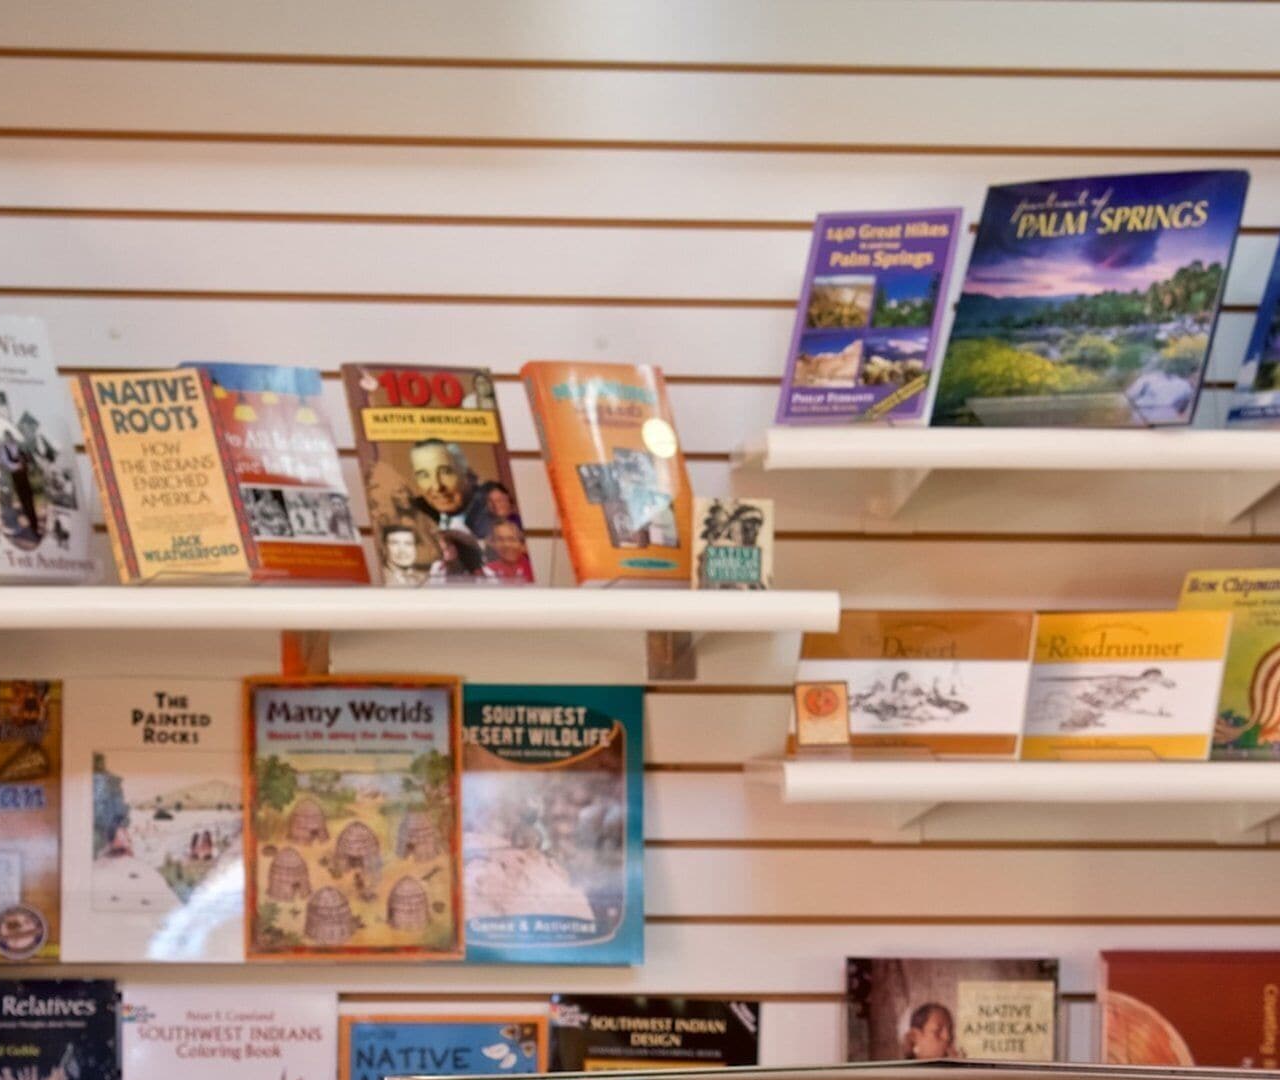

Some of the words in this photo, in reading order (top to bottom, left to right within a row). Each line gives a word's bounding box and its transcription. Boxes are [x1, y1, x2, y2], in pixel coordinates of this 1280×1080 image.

[1017, 209, 1091, 240] PALM
[1094, 200, 1208, 235] SPRINGS
[825, 228, 856, 244] 140
[858, 223, 899, 242] Great
[902, 220, 950, 241] Hikes
[829, 248, 871, 268] Palm
[874, 247, 935, 270] Springs
[95, 376, 200, 406] NATIVE
[379, 370, 464, 408] 100
[111, 406, 200, 436] ROOTS
[372, 413, 416, 426] NATIVE
[419, 414, 488, 427] AMERICANS
[140, 441, 181, 458] HOW
[119, 459, 147, 473] THE
[150, 456, 215, 474] INDIANS
[132, 473, 209, 490] ENRICHED
[139, 489, 210, 508] AMERICA
[170, 534, 202, 549] JACK
[142, 543, 240, 564] WEATHERFORD
[1183, 576, 1214, 593] How
[879, 636, 958, 660] Desert
[1048, 634, 1183, 658] Roadrunner
[155, 692, 189, 710] THE
[131, 708, 211, 728] PAINTED
[267, 700, 340, 729] Many
[347, 699, 434, 725] Worlds
[481, 705, 587, 726] SOUTHWEST
[143, 727, 200, 745] ROCKS
[462, 726, 524, 746] DESERT
[528, 726, 612, 747] WILDLIFE
[533, 919, 597, 935] Activities
[2, 995, 97, 1017] Relatives
[976, 1003, 1032, 1019] NATIVE
[137, 1026, 245, 1043] SOUTHWEST
[249, 1026, 323, 1043] INDIANS
[589, 1017, 671, 1033] SOUTHWEST
[675, 1017, 727, 1034] INDIAN
[962, 1021, 1048, 1036] AMERICAN
[628, 1032, 682, 1048] DESIGN
[983, 1038, 1026, 1054] FLUTE
[175, 1043, 242, 1060] Coloring
[245, 1043, 282, 1059] Book
[352, 1046, 470, 1070] NATIVE
